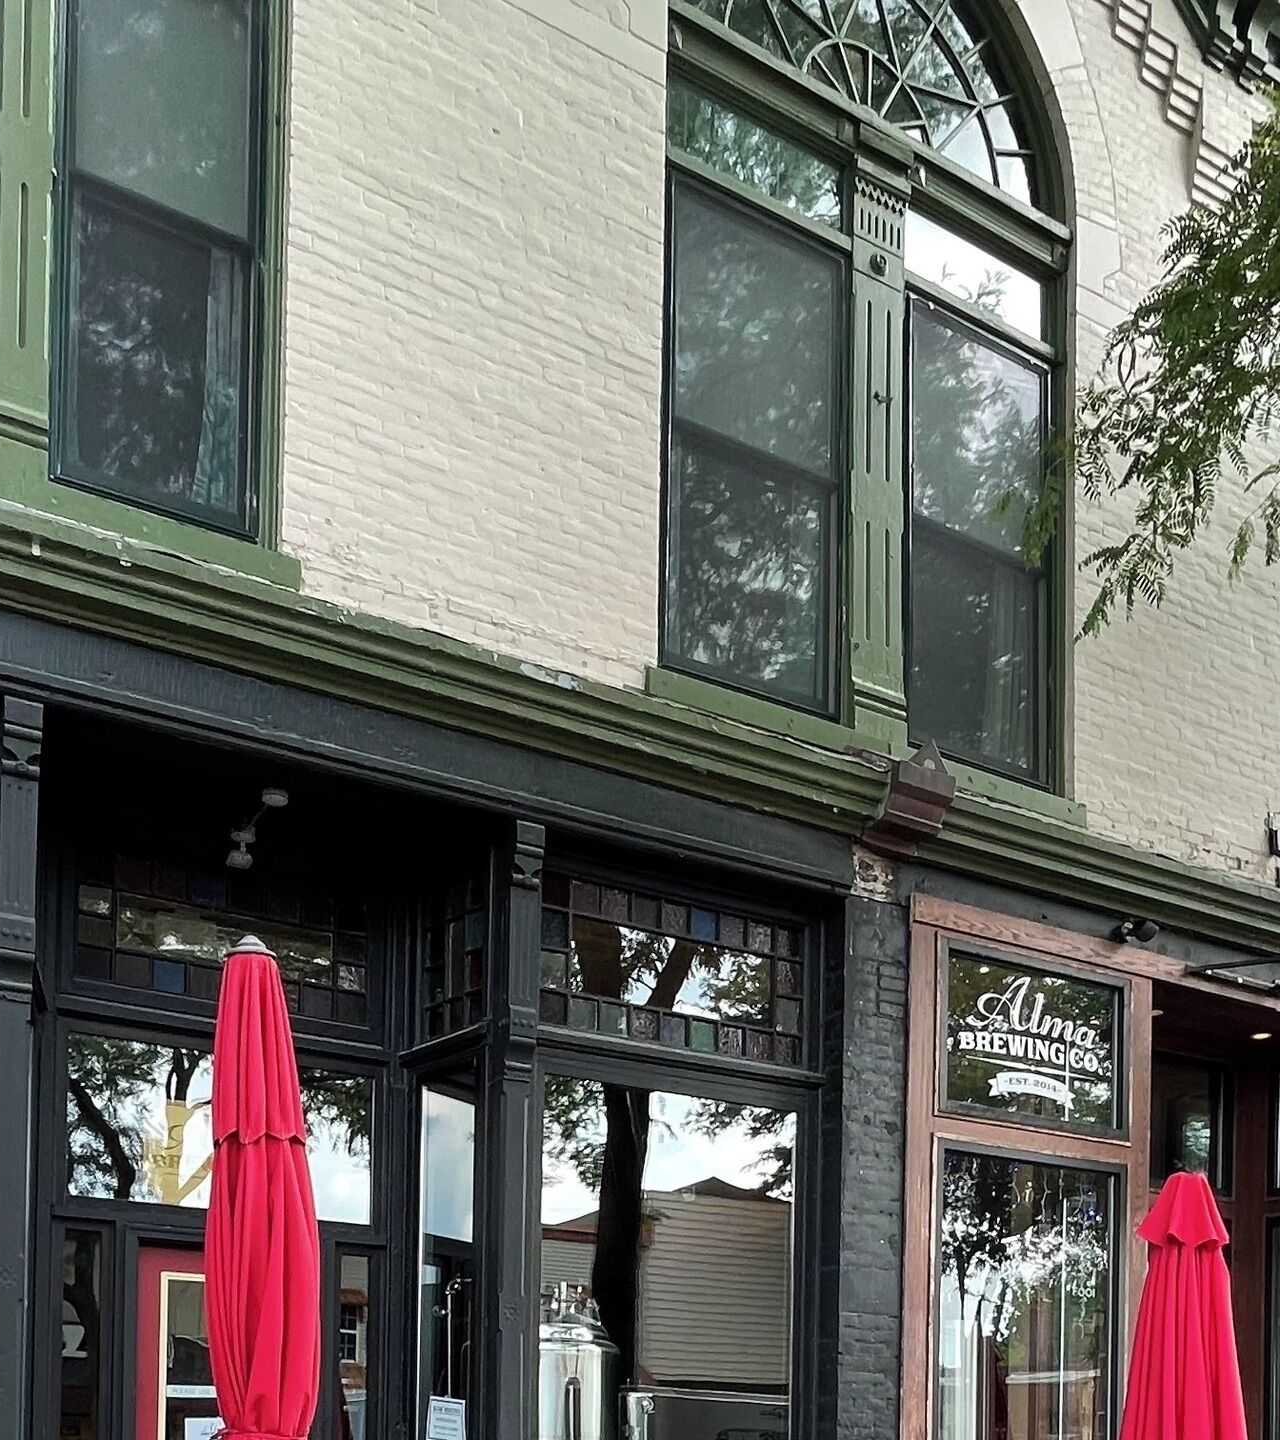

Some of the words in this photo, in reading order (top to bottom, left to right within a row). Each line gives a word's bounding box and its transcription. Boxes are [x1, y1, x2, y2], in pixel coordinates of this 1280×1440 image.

[965, 976, 1098, 1049] Alma
[958, 1031, 1066, 1066] BREWING
[1069, 1047, 1104, 1076] CO.
